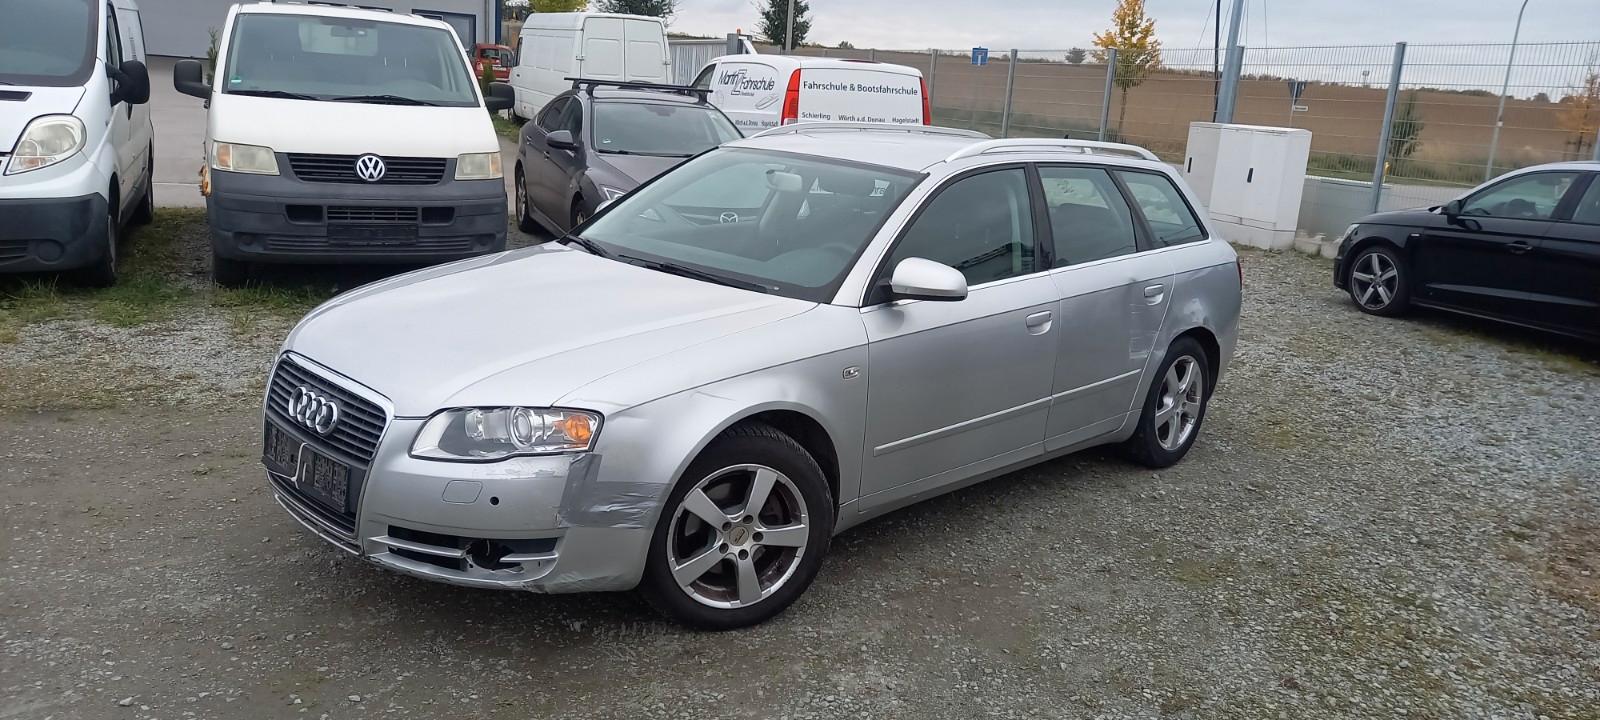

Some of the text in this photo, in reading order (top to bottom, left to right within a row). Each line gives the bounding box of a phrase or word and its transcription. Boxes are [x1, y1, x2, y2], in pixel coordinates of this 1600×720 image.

[803, 81, 918, 96] Fahrschule & Bootsfahrschule
[801, 112, 831, 121] Schierling
[838, 114, 856, 122] Wörth
